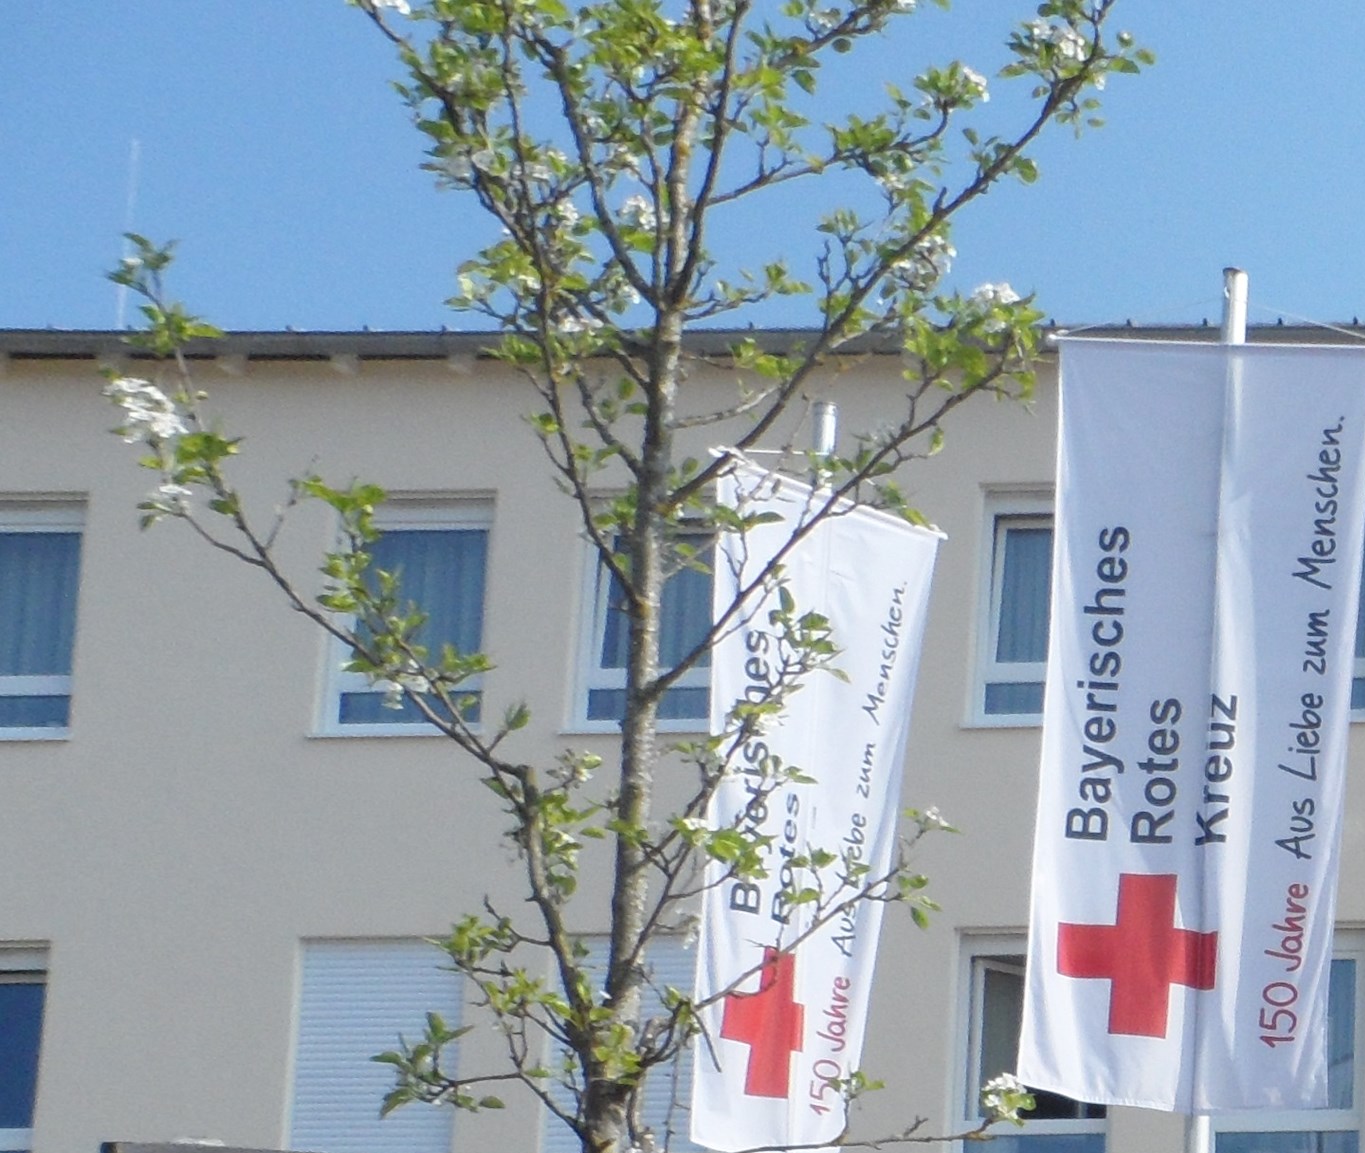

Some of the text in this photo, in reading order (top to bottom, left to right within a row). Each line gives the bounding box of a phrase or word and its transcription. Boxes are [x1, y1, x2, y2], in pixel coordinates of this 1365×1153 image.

[862, 580, 908, 726] Menschen.
[1065, 525, 1131, 842] Bayerisches
[856, 743, 876, 799] zum
[1130, 697, 1182, 845] Rotes
[1194, 693, 1238, 846] Kreuz
[1259, 416, 1345, 1048] 150 Jahre Aus Liebe zum Menschen.
[809, 1059, 842, 1116] 150
[816, 976, 851, 1052] Jahre
